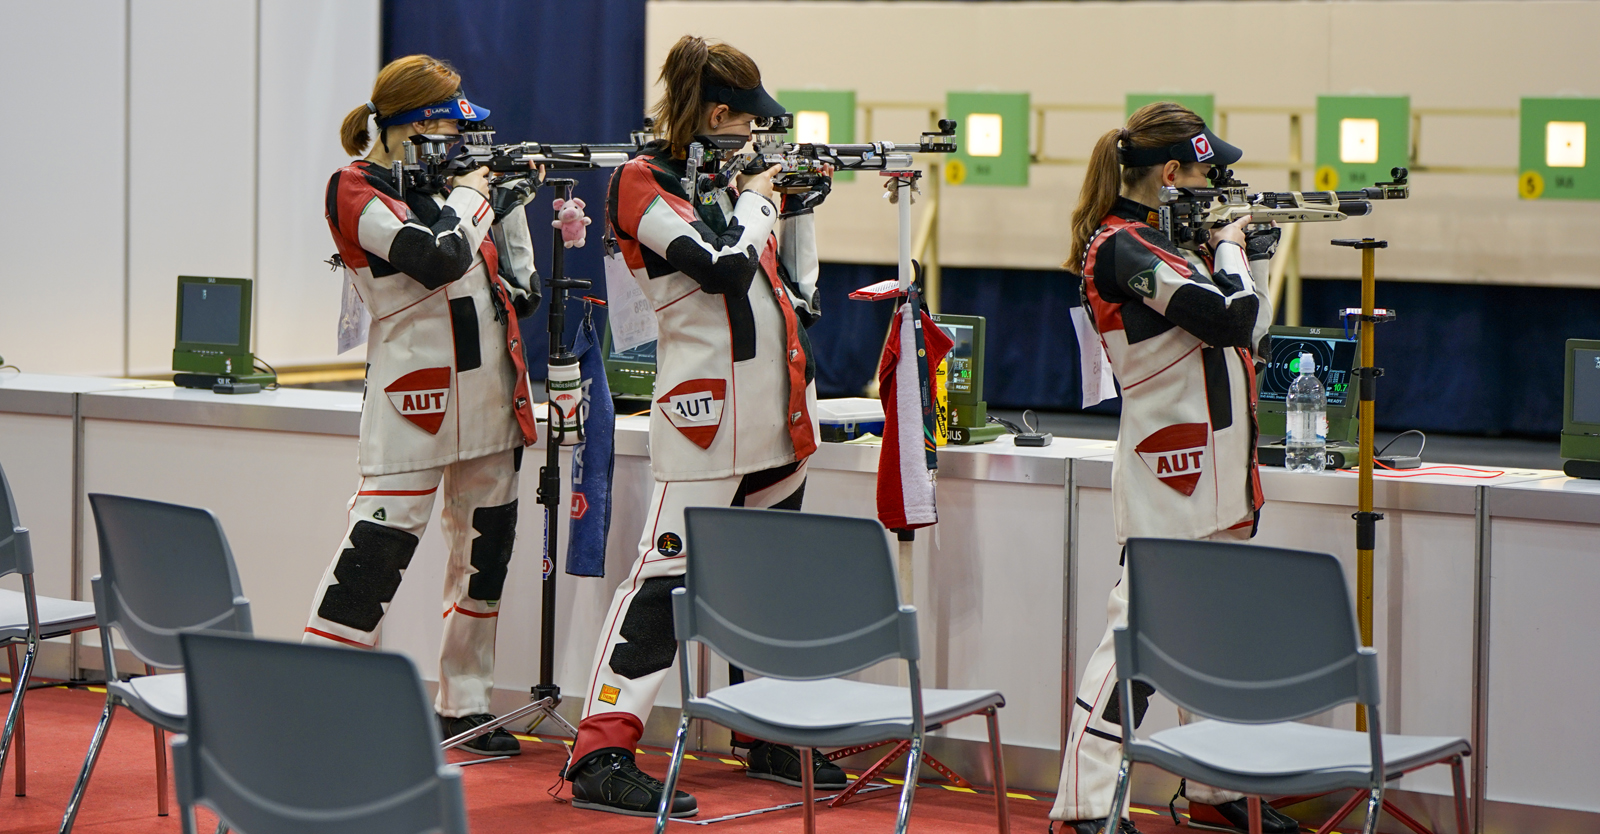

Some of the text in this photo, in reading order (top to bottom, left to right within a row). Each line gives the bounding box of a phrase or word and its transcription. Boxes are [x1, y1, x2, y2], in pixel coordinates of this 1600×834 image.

[1321, 170, 1330, 186] 4
[1526, 176, 1536, 195] 5
[1333, 383, 1348, 392] 10.7
[402, 392, 445, 412] AUT
[676, 396, 712, 418] AUT
[1156, 450, 1204, 474] AUT
